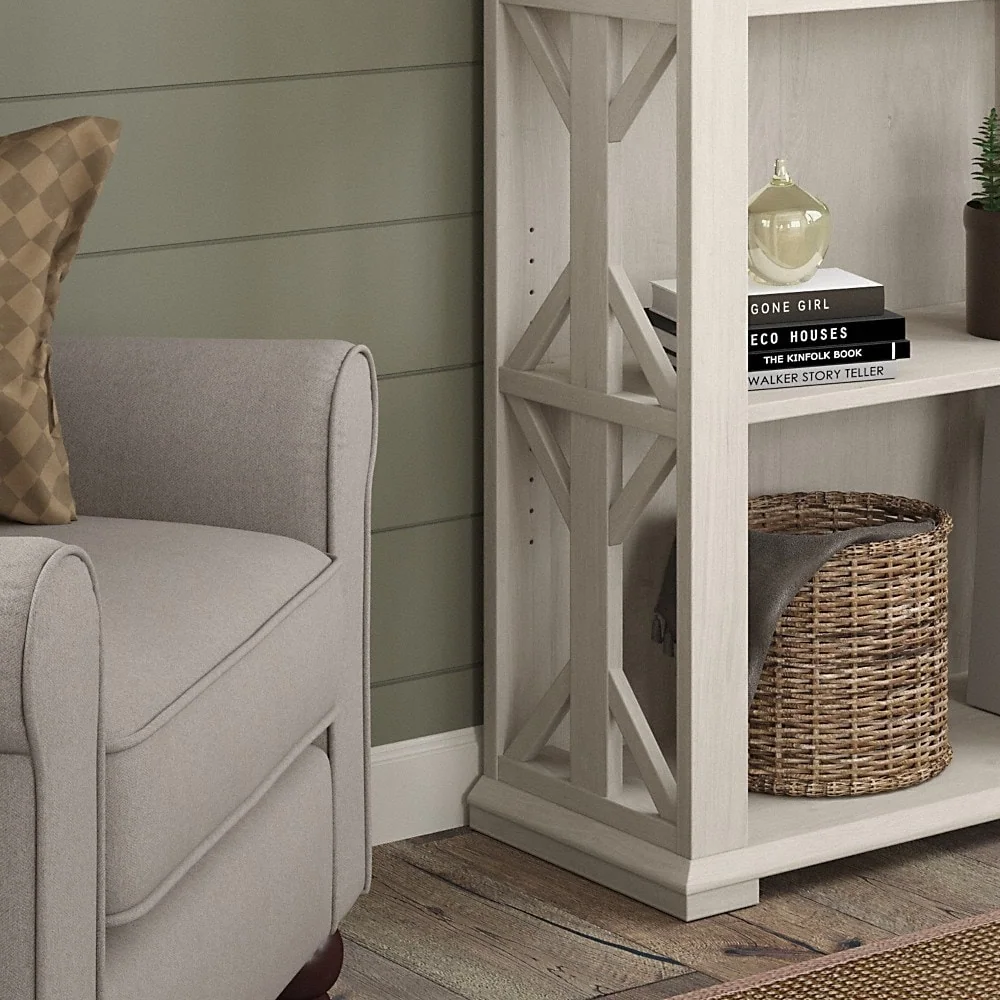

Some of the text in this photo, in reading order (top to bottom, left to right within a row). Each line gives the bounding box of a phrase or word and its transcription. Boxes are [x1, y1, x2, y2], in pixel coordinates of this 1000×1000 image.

[750, 298, 830, 315] GONE GIRL
[750, 326, 848, 346] ECO HOUSES
[763, 348, 862, 365] THE KINFOLK BOOK
[748, 365, 884, 386] WALKER STORY TELLER
